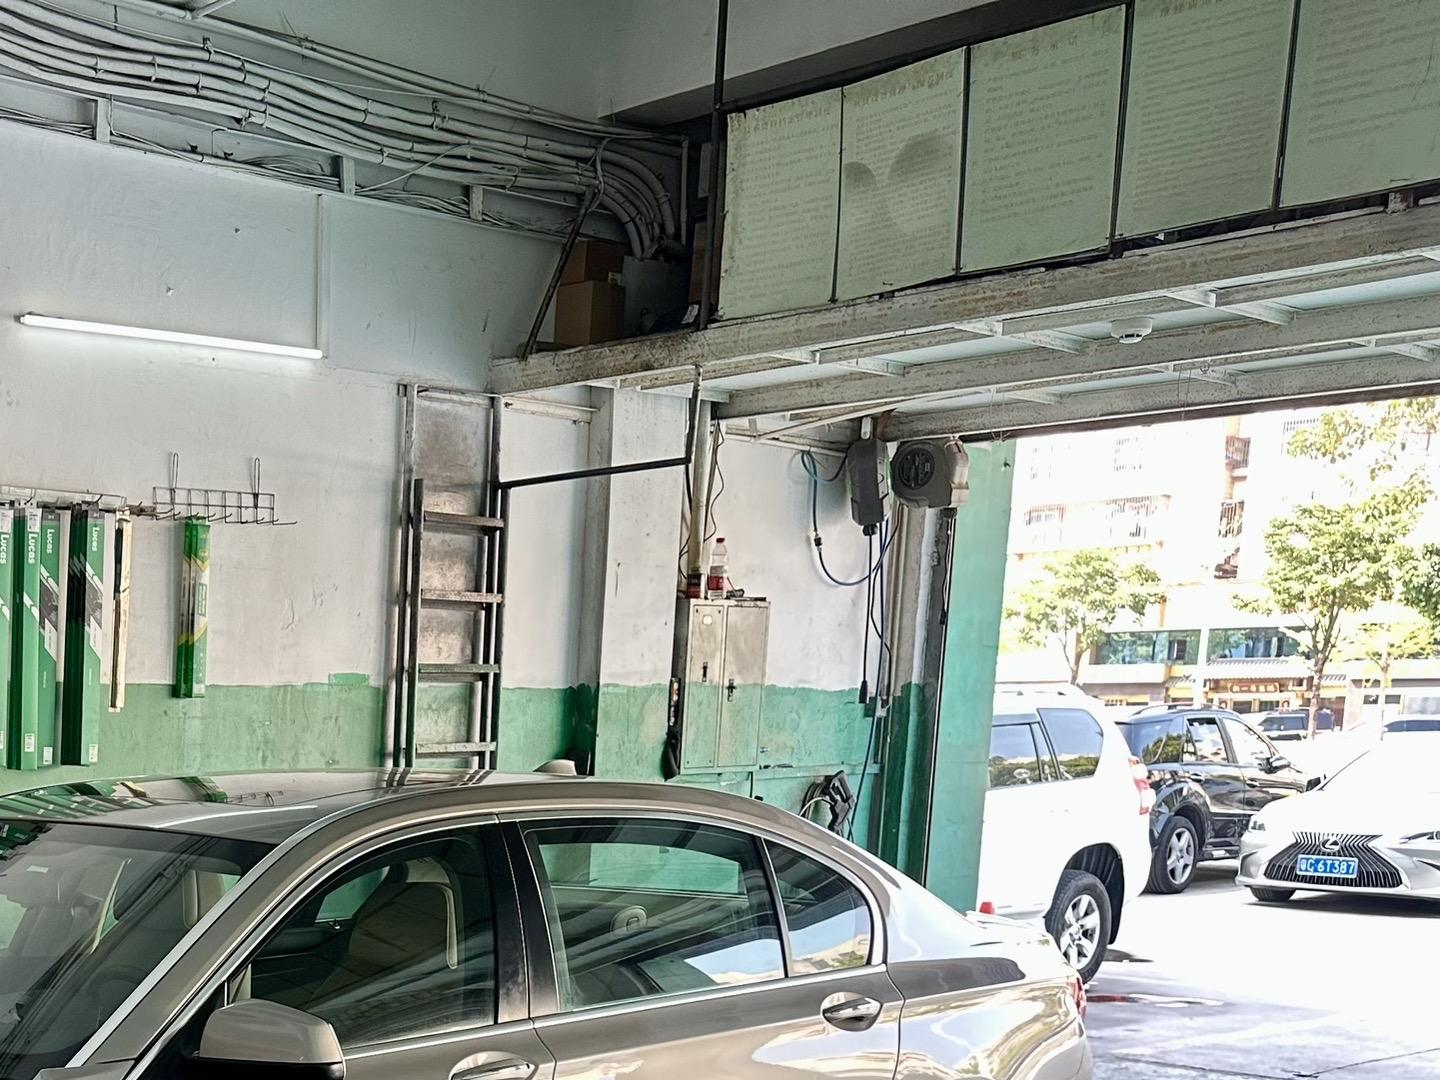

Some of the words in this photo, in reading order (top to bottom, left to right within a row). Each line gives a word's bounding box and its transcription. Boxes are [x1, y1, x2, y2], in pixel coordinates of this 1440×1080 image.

[0, 534, 9, 565] Lucas
[28, 532, 38, 564] Lucas
[46, 528, 55, 554] Lucas
[91, 526, 100, 552] Lucas
